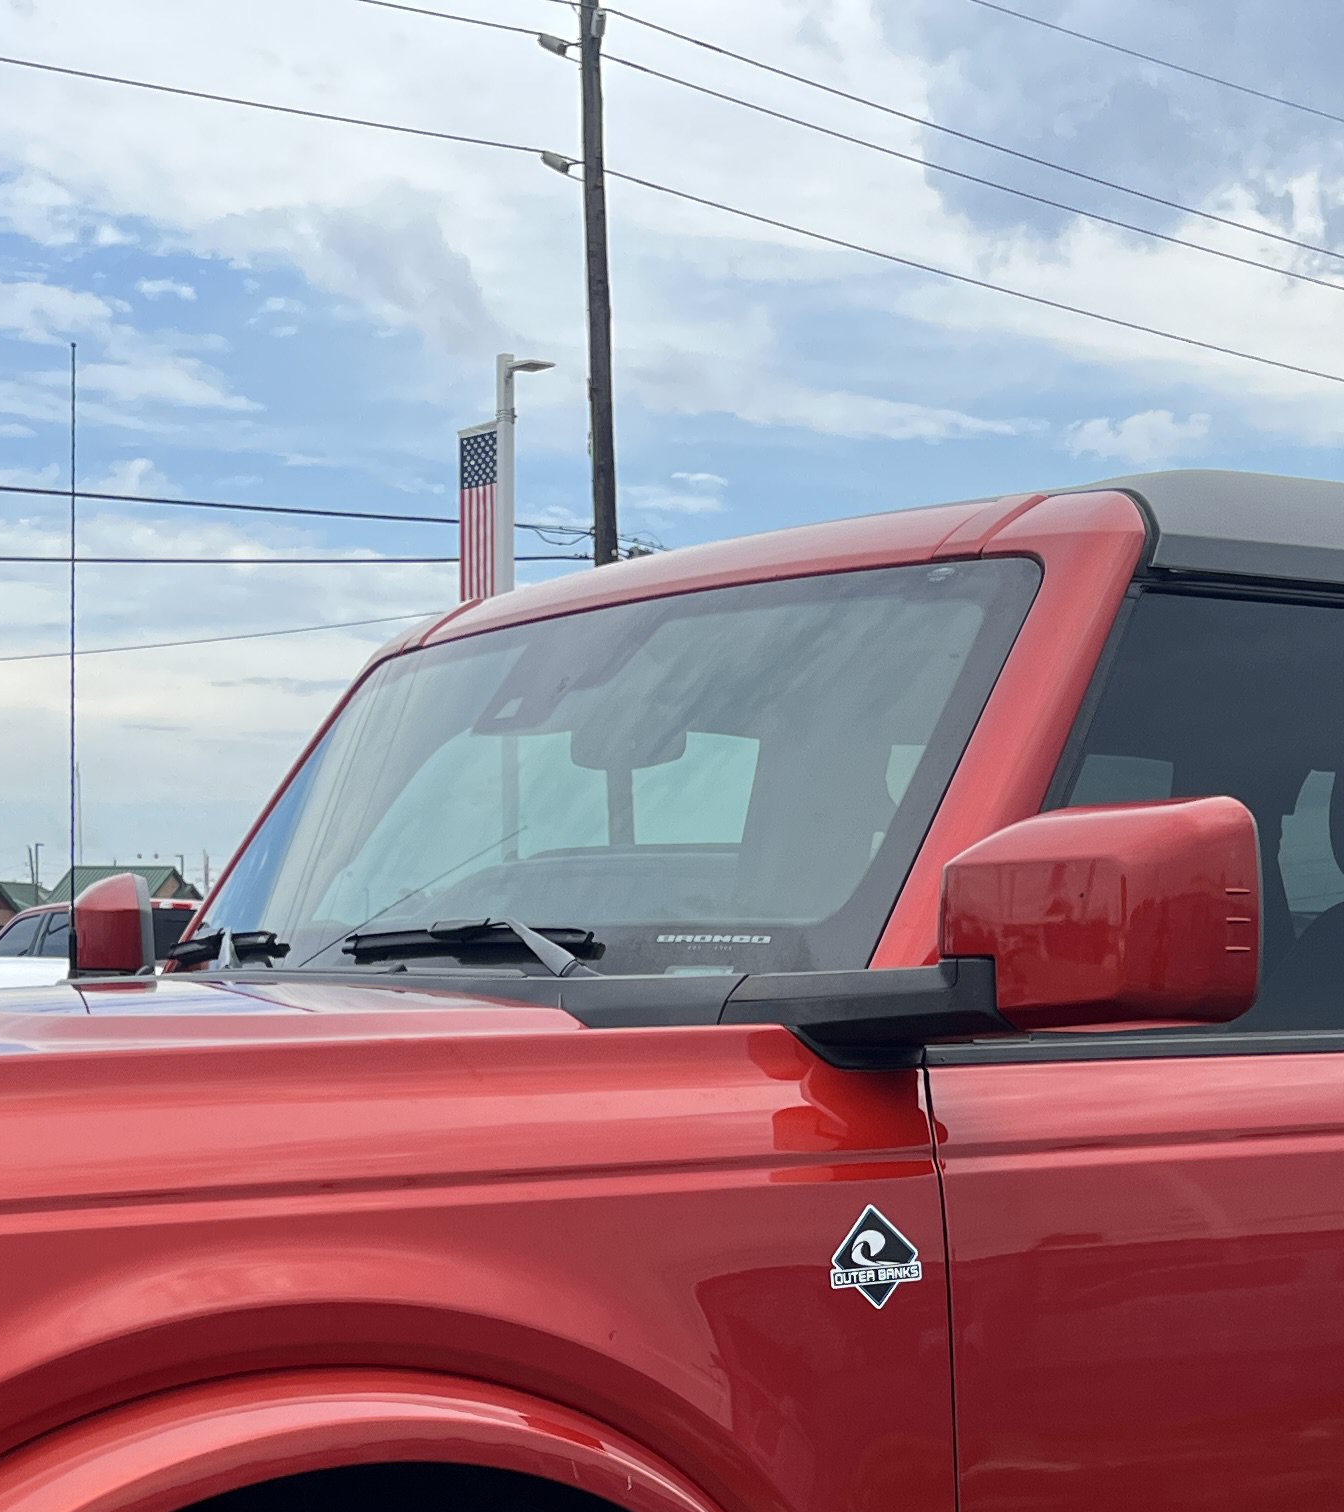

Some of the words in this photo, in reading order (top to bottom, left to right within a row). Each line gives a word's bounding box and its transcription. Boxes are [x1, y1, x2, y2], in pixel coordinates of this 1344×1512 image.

[656, 934, 772, 944] BRONCO
[834, 1271, 875, 1286] OUTER
[878, 1265, 919, 1281] BANKS
